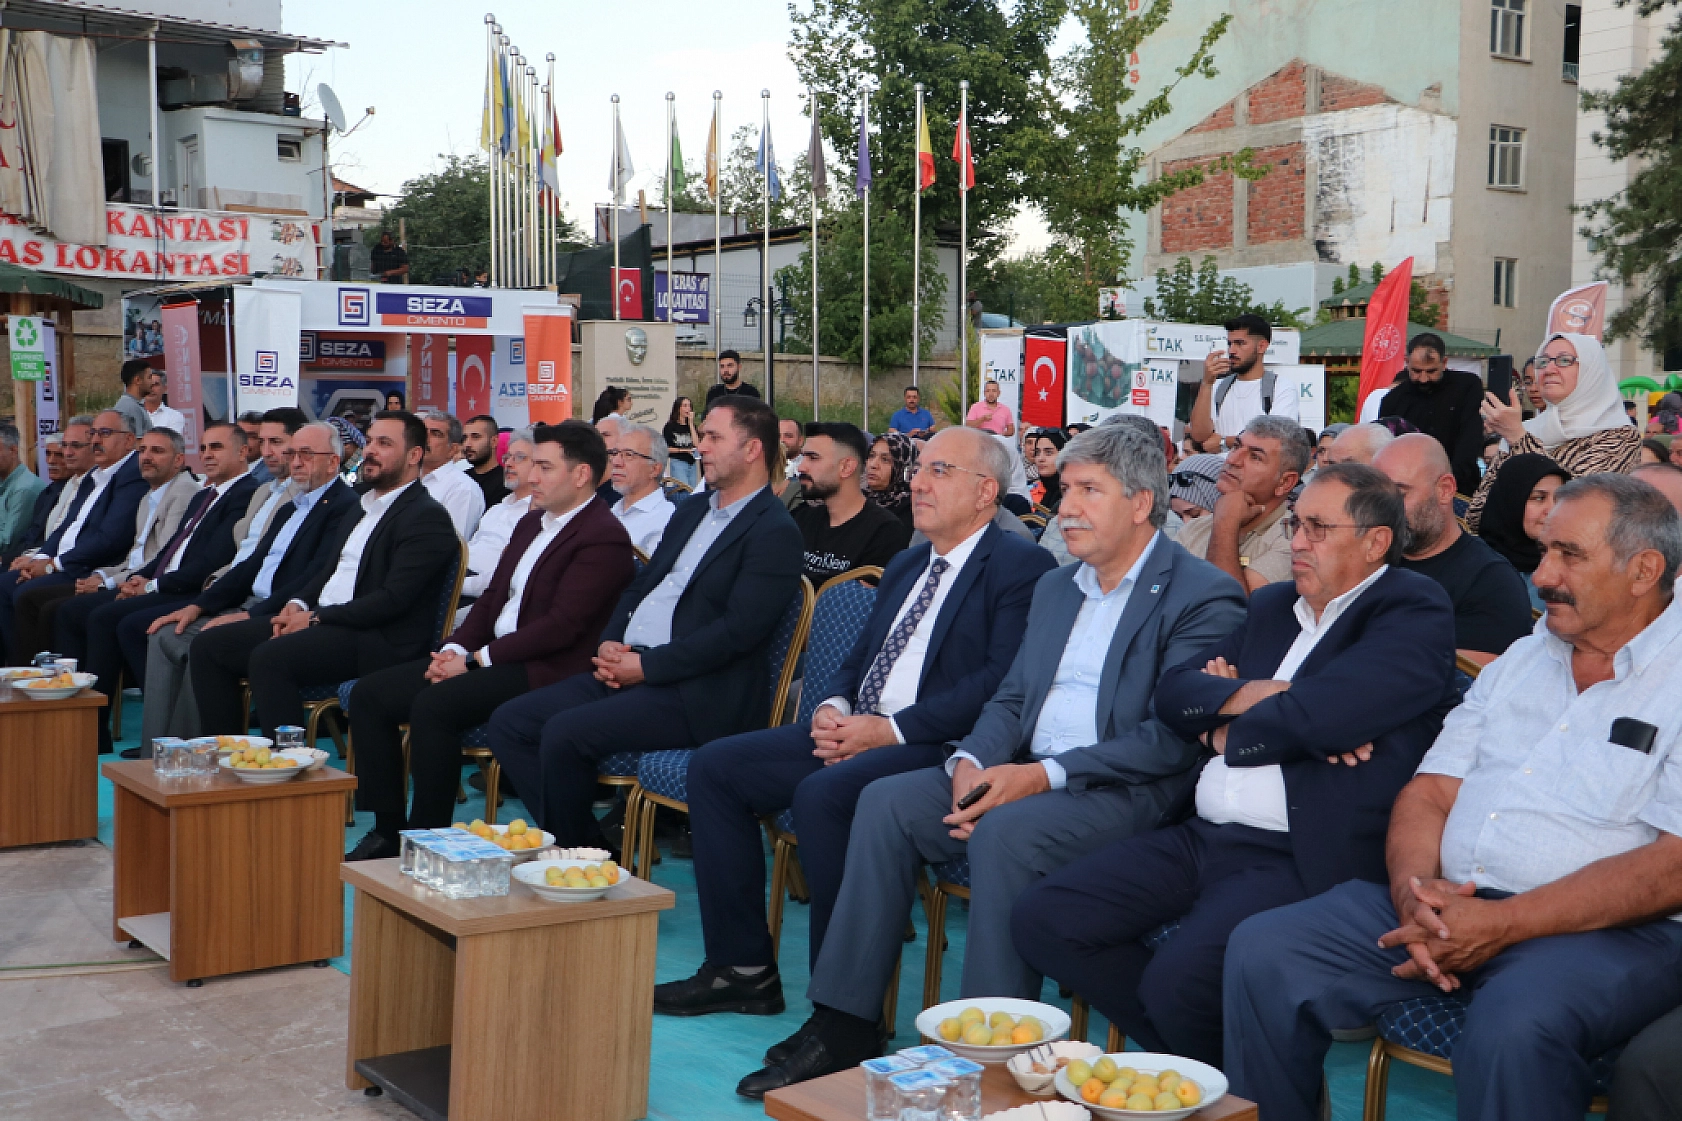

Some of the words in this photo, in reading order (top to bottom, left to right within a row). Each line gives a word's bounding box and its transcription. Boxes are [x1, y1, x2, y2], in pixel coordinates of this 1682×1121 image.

[54, 243, 249, 276] LOKANTASI
[407, 296, 467, 315] SEZA
[320, 341, 372, 356] SEZA
[239, 374, 294, 389] SEZA
[528, 383, 568, 395] SEZA
